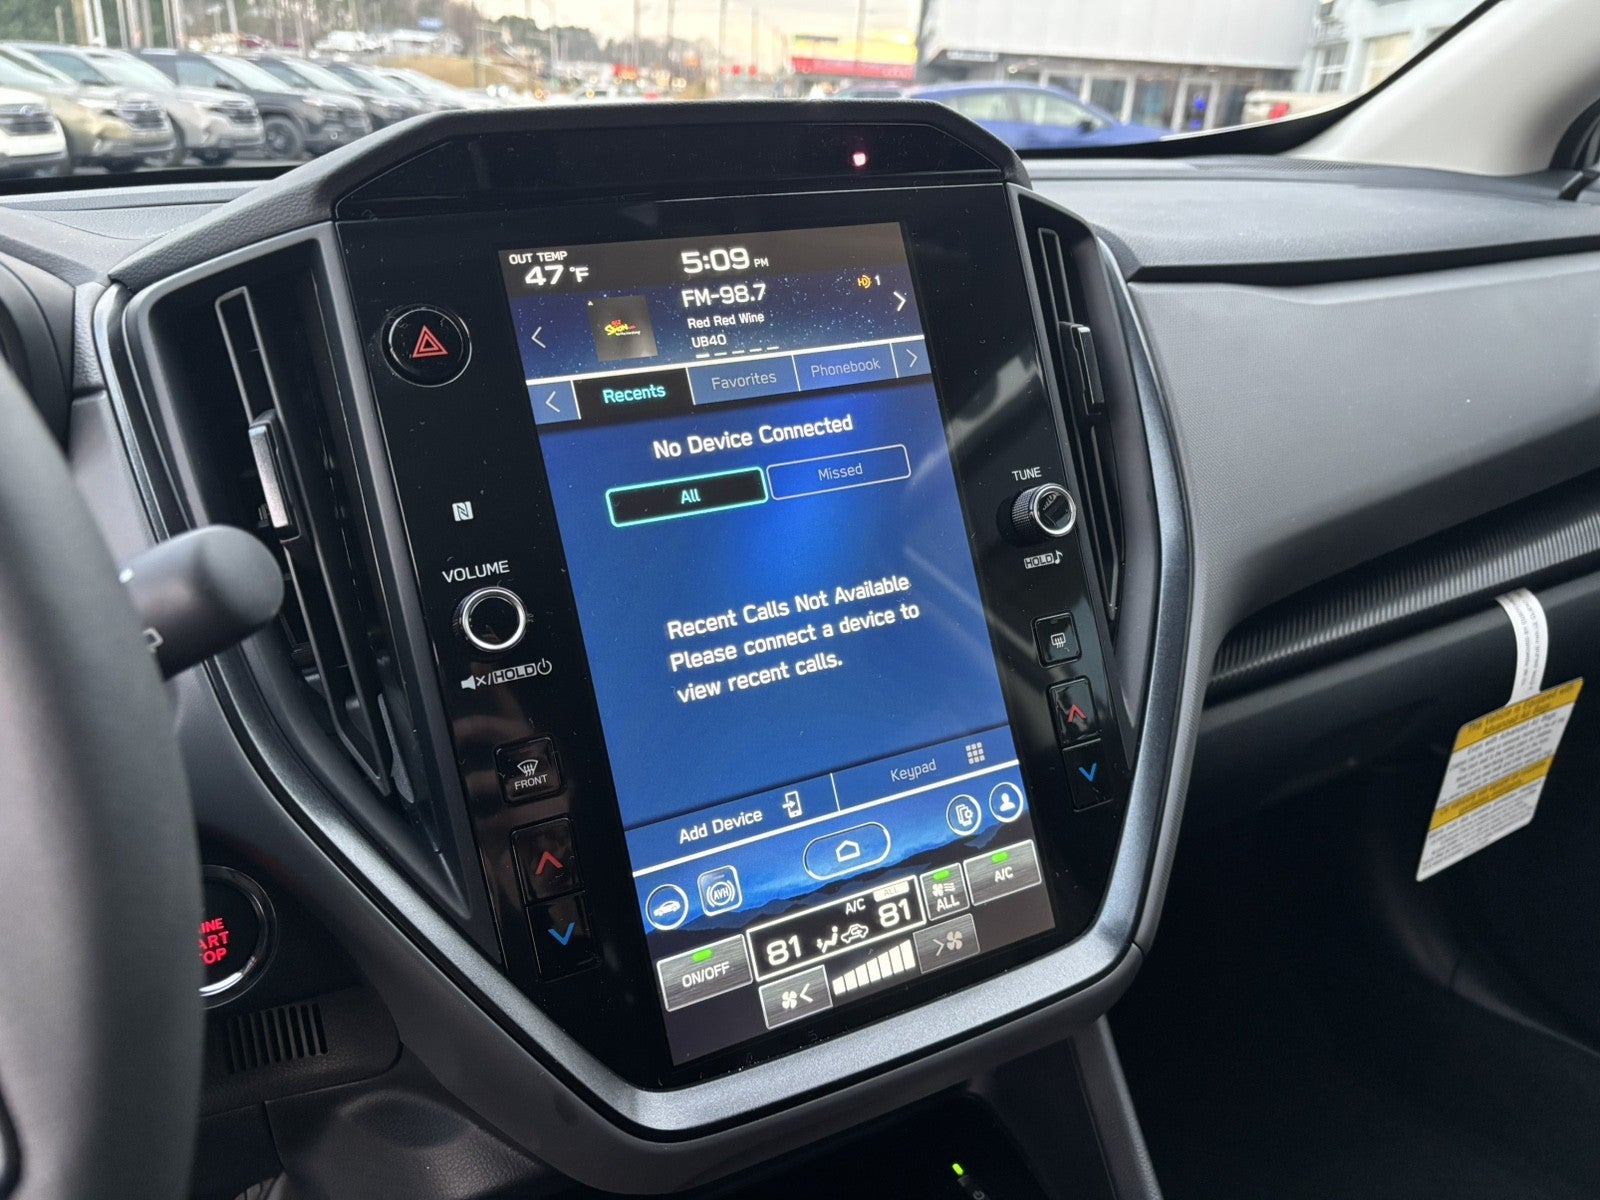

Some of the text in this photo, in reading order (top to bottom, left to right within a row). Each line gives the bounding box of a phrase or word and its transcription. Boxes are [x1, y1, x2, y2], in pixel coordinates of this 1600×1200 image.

[508, 251, 568, 265] OUT TEMP
[681, 247, 769, 274] 5:09 PM
[524, 264, 564, 286] 47
[874, 274, 881, 286] 1
[682, 283, 767, 308] FM-98.7
[688, 312, 765, 329] Red Red Wine
[691, 334, 727, 348] UB40
[810, 357, 881, 377] Phonebook
[711, 371, 777, 390] Favorites
[602, 383, 666, 404] Recents
[653, 413, 854, 459] No Device Connected
[818, 462, 864, 482] Missed
[1012, 467, 1042, 481] TUNE
[680, 488, 701, 504] All
[1024, 552, 1054, 569] HOLD
[442, 560, 510, 583] VOLUME
[667, 574, 911, 640] Recent Calls Not Available
[669, 602, 921, 672] Please connect a device to
[677, 651, 844, 703] view recent calls.
[890, 758, 938, 783] Keypad
[514, 774, 548, 790] FRONT
[679, 809, 763, 844] Add Device
[994, 865, 1014, 883] A/C
[713, 885, 730, 900] AVH
[845, 898, 867, 915] A/C
[878, 898, 912, 929] 81
[936, 899, 961, 912] ALL
[200, 917, 224, 933] INE
[202, 947, 227, 964] OP
[766, 935, 802, 966] 81
[681, 960, 730, 988] ON/OFF
